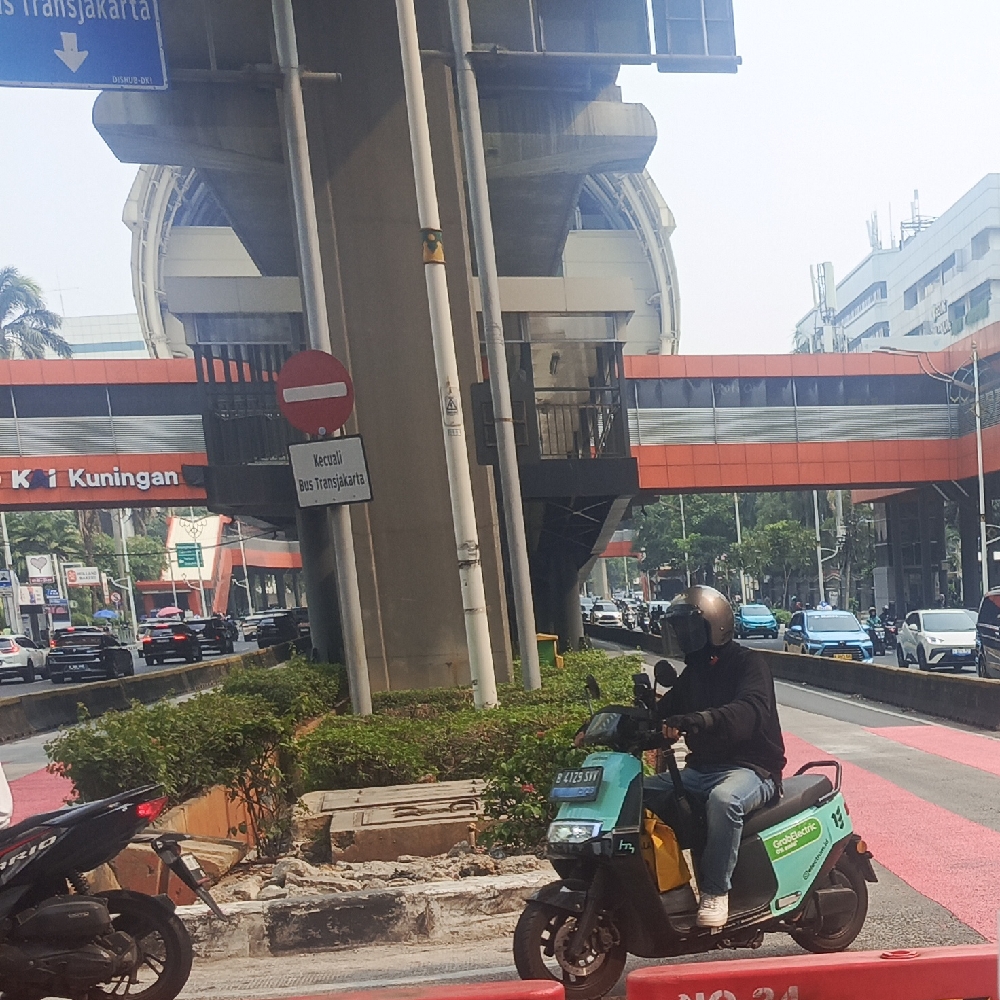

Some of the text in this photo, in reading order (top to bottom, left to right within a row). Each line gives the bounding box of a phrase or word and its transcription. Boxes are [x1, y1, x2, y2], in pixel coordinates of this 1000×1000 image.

[313, 450, 343, 467] Kecuali
[68, 466, 179, 490] Kuningan
[299, 472, 365, 492] Bus Transjakarta
[772, 822, 818, 849] GrabElectric
[0, 835, 57, 870] RIO
